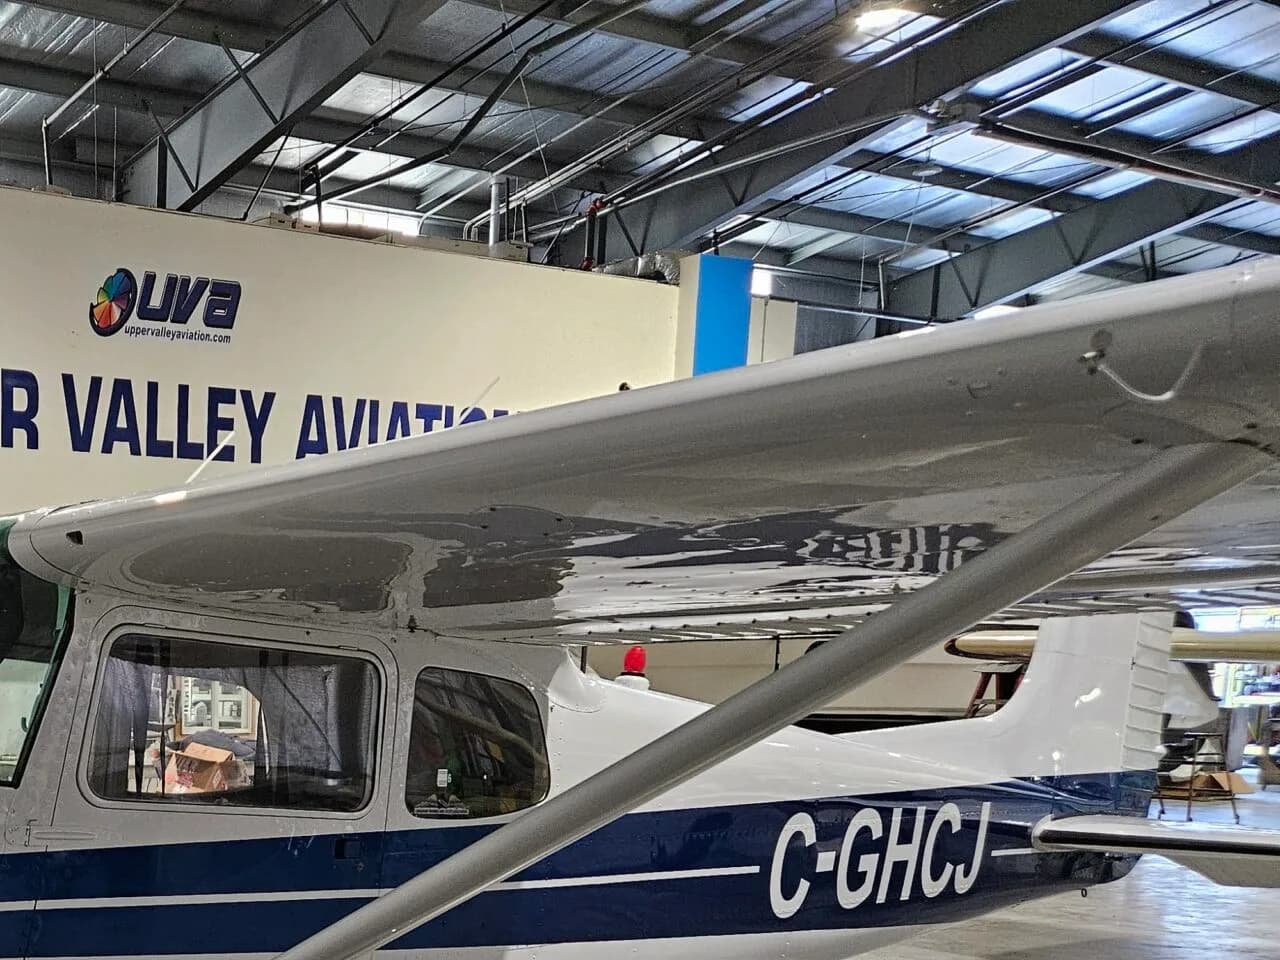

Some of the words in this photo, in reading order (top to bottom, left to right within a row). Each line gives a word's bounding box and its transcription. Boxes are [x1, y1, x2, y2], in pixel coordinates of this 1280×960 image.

[124, 324, 231, 344] uppervalleyaviation.com
[61, 372, 277, 464] VALLEY
[295, 393, 521, 460] AVIAT
[769, 801, 992, 919] C-GHCJ
